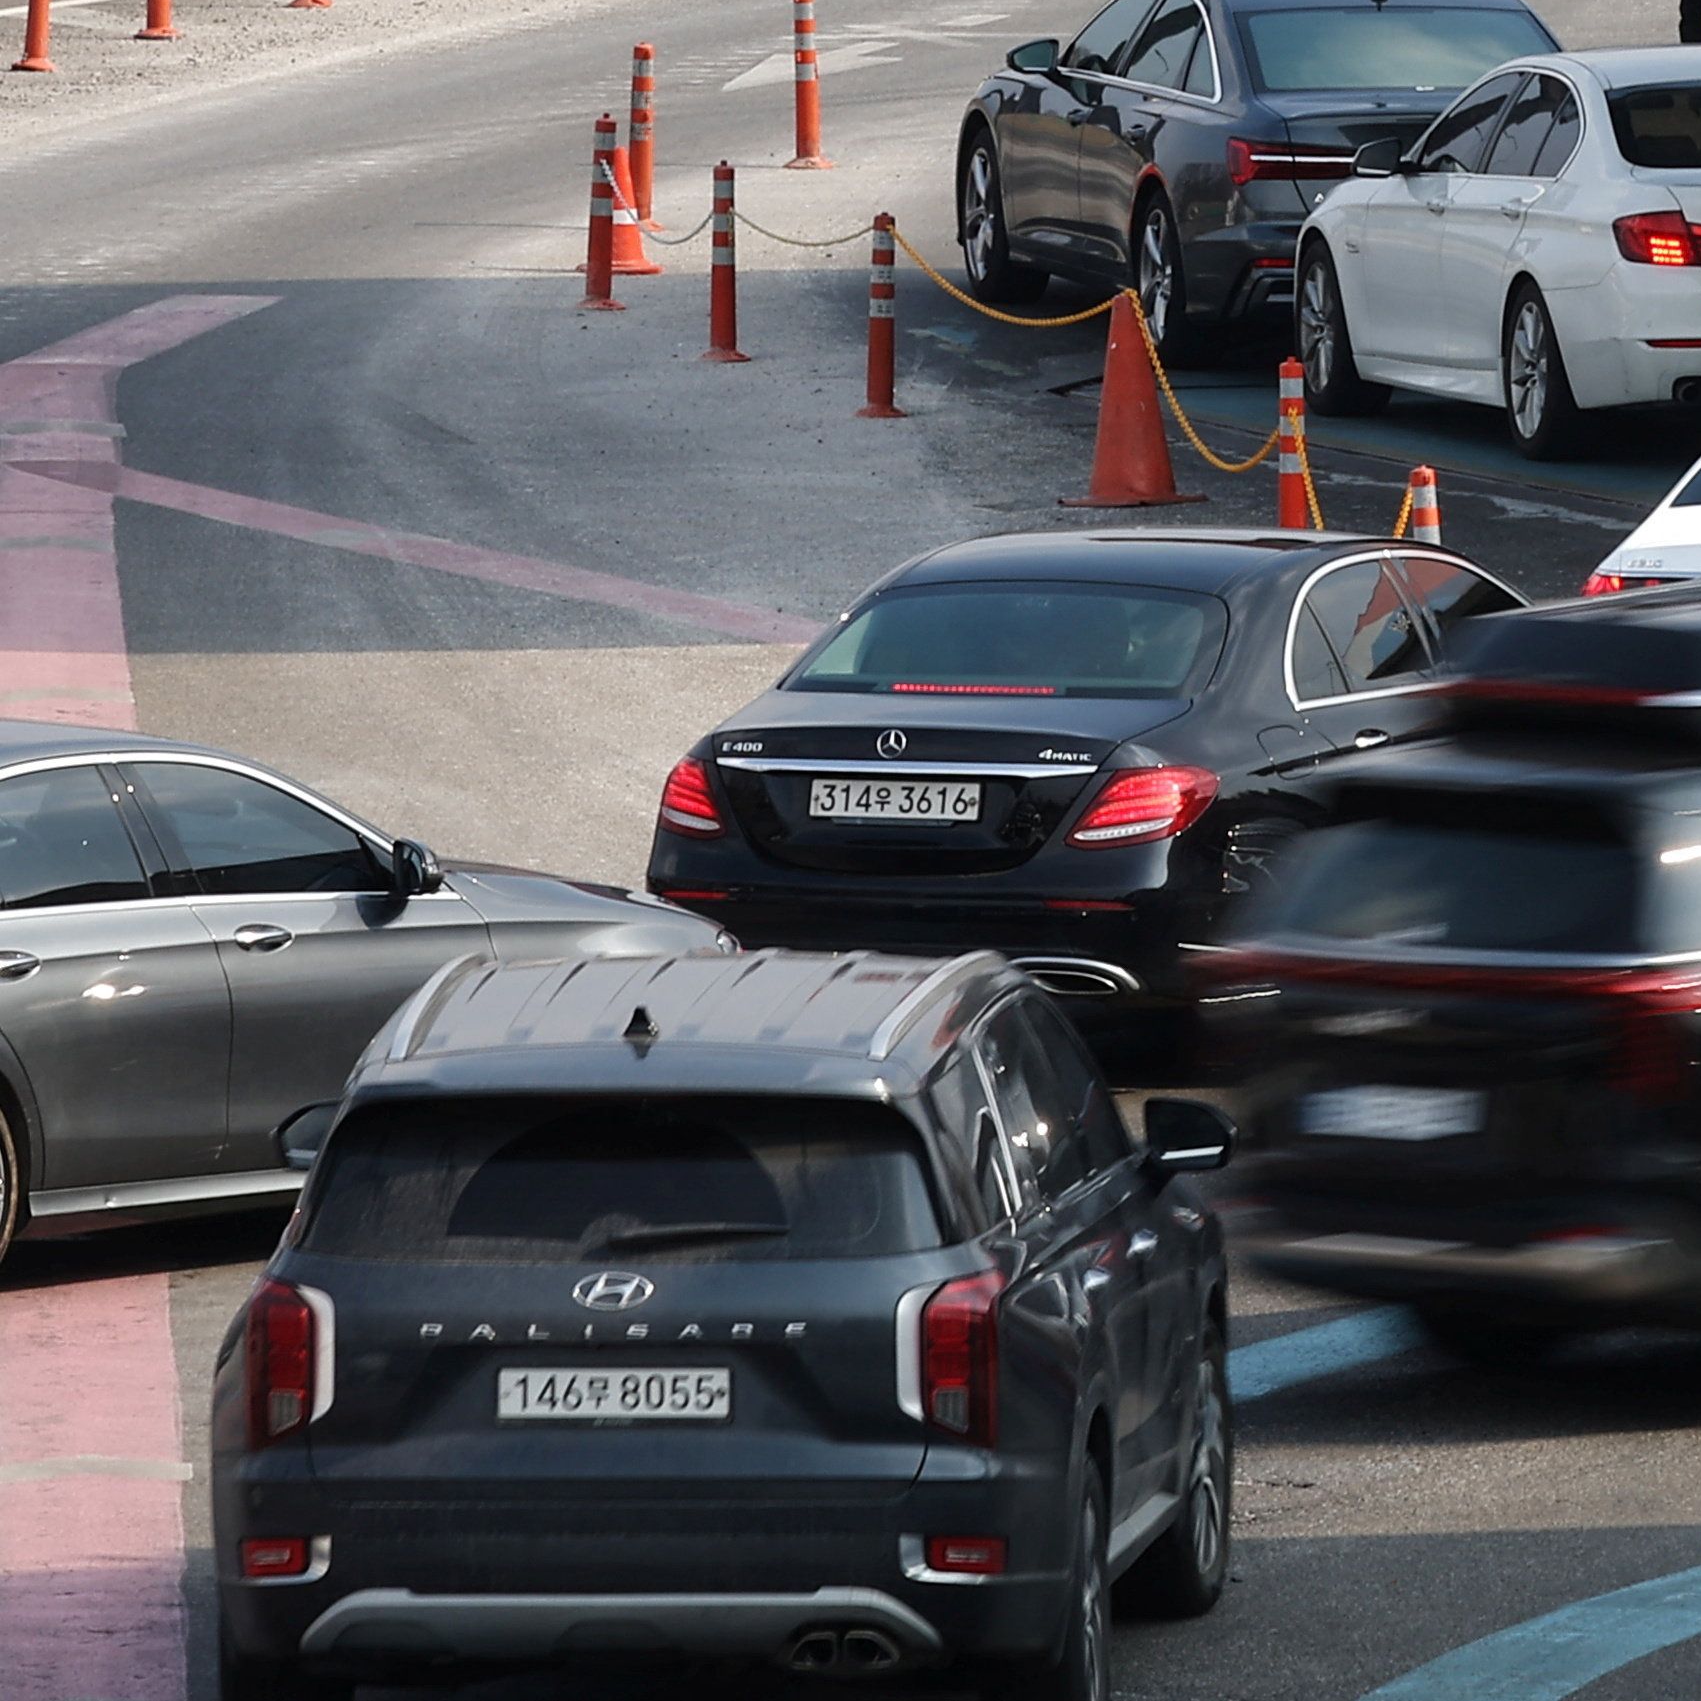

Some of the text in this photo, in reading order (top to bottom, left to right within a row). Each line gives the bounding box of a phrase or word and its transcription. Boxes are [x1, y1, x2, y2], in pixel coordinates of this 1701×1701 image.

[820, 785, 970, 815] 314우 3616
[619, 1373, 717, 1412] 8055
